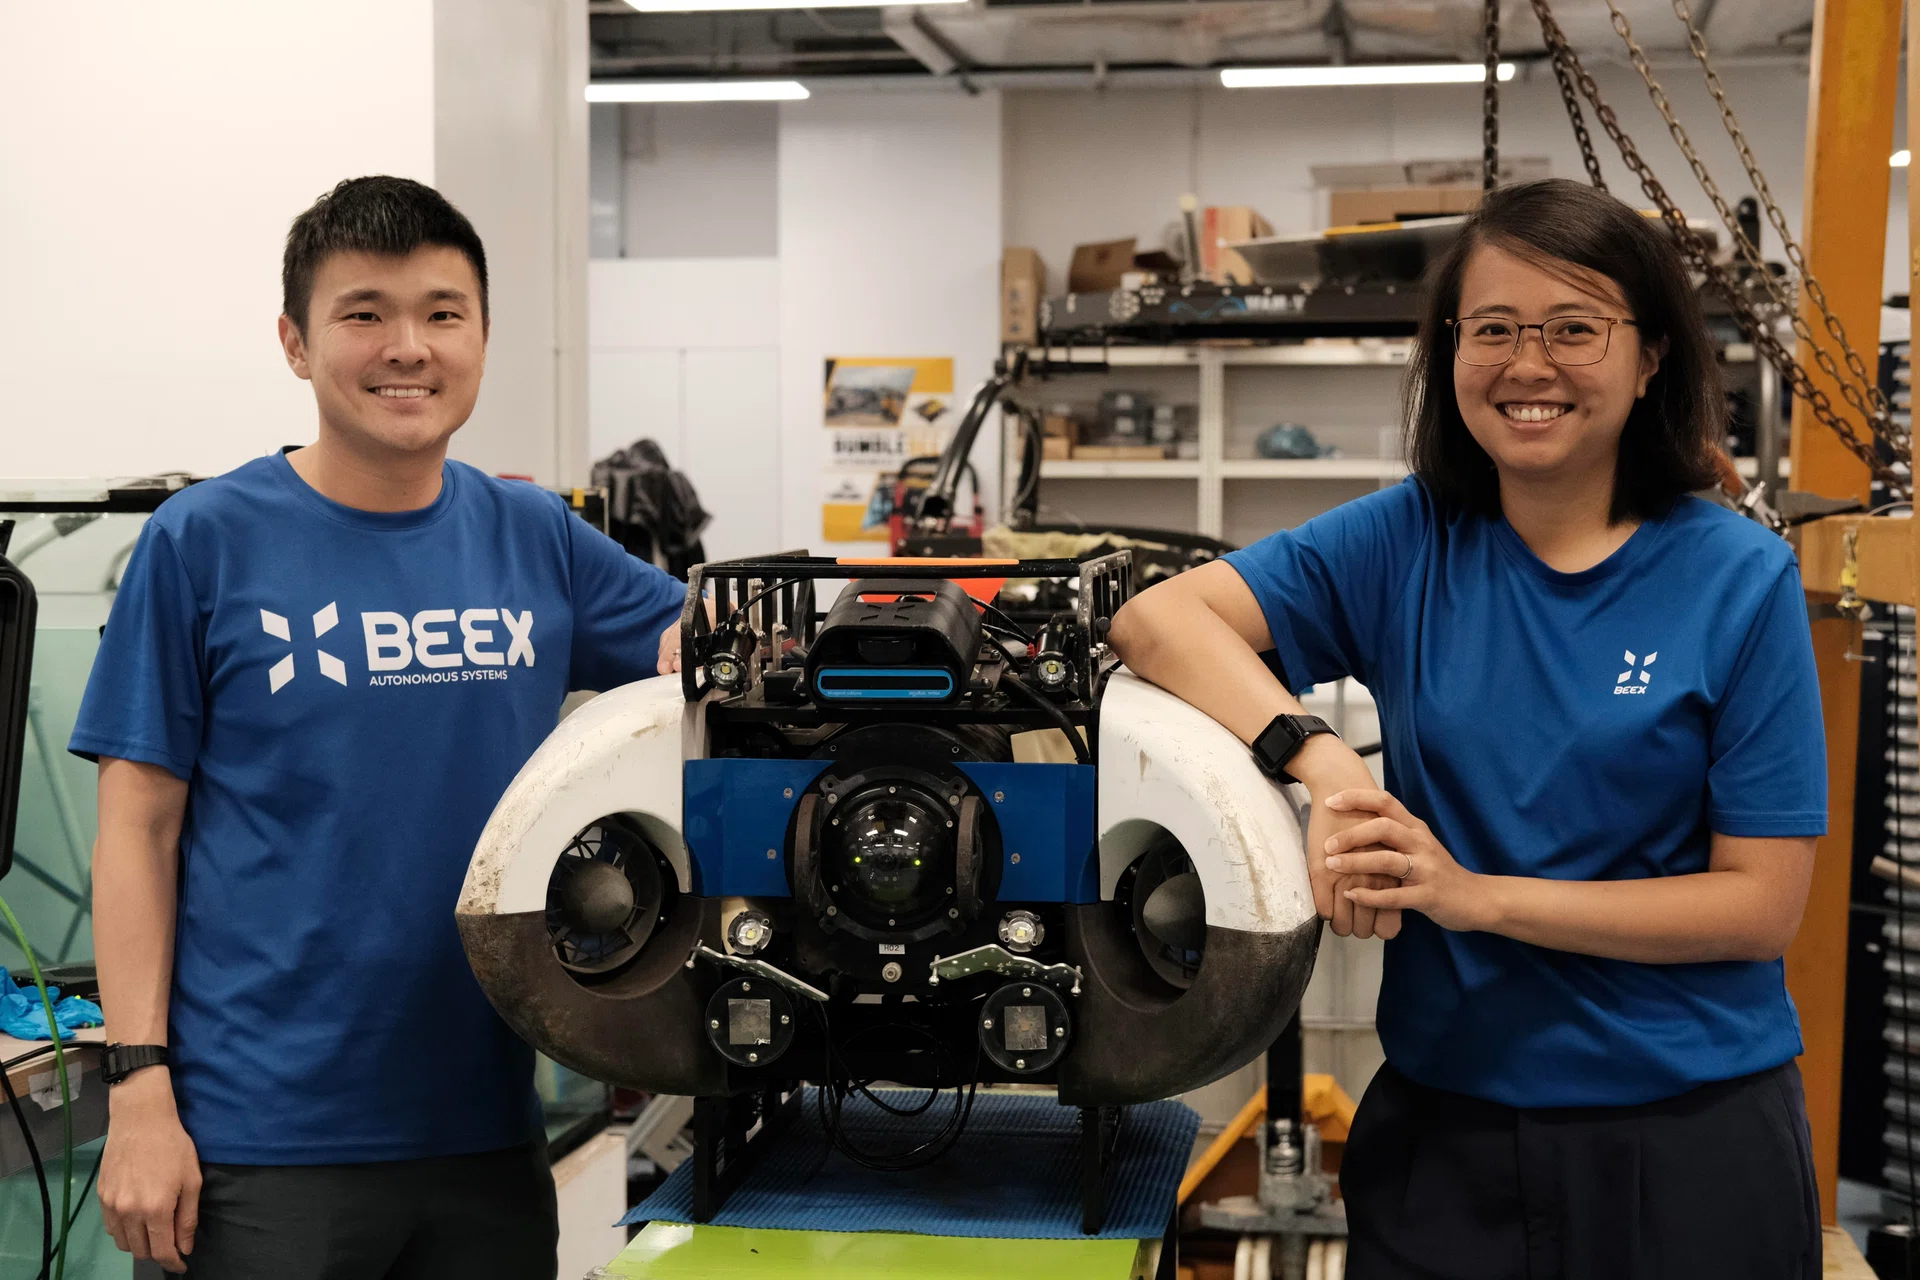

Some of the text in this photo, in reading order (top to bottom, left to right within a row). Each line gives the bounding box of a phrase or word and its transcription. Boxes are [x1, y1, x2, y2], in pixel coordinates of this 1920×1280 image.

[361, 608, 535, 671] BEEX
[369, 669, 508, 686] AUTONOMOUS SYSTEMS
[1613, 686, 1648, 694] BEEX
